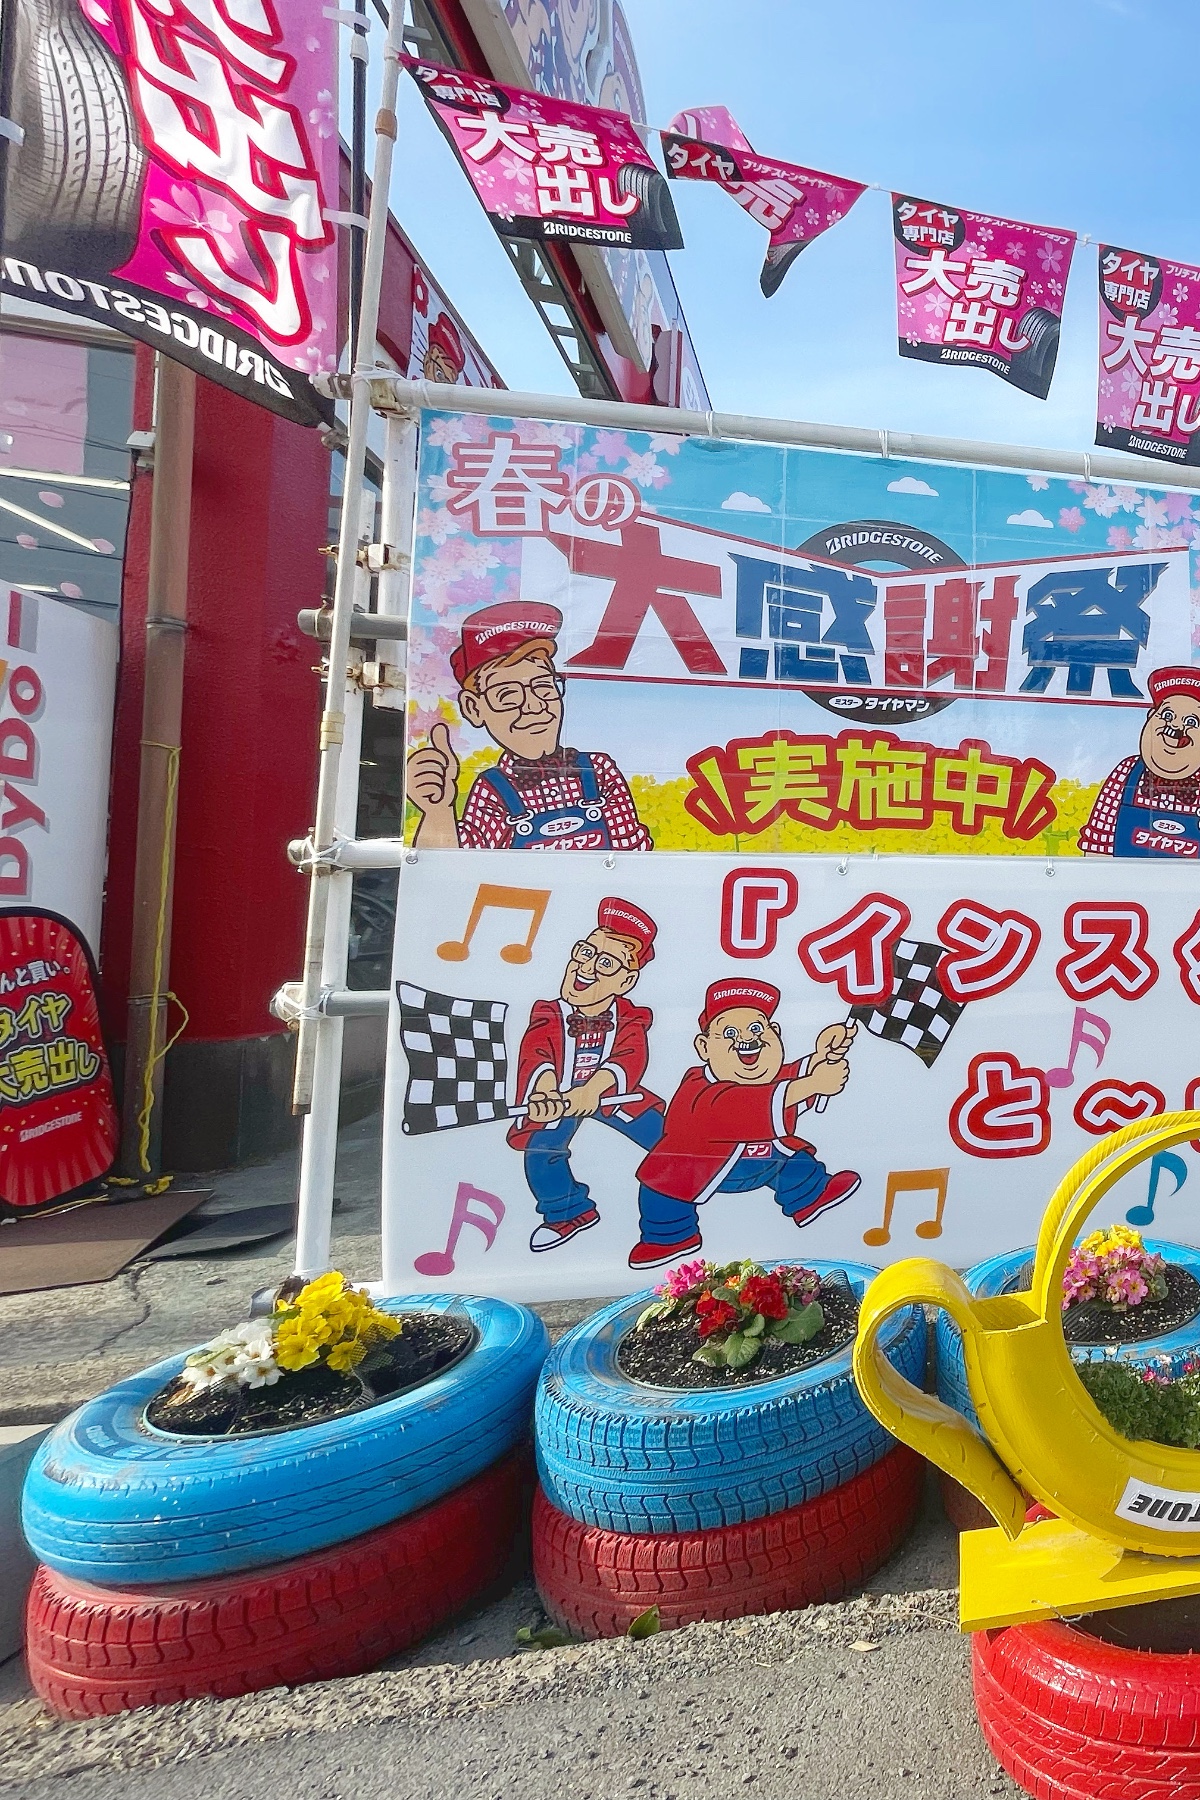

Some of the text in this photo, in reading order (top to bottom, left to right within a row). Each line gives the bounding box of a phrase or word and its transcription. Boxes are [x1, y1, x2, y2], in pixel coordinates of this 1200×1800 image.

[430, 85, 502, 108] 専門店
[457, 111, 603, 166] 大売
[667, 142, 735, 181] タイヤ
[537, 166, 639, 217] 出し
[897, 201, 959, 228] タイヤ
[543, 221, 632, 244] BRIDGESTONE
[902, 225, 955, 247] 専門店
[901, 249, 1026, 307] 大売
[1102, 252, 1159, 286] タイヤ
[1103, 281, 1152, 310] 専門店
[943, 301, 1031, 351] 出し
[940, 347, 1011, 375] BRIDGESTONE
[1127, 434, 1188, 459] BRIDGESTONE
[448, 433, 640, 536] 春の
[824, 531, 945, 565] BRIDGESTONE
[547, 522, 1171, 698] 大感謝祭
[474, 620, 558, 646] BRIDGESTONE
[864, 696, 930, 713] タイヤマン
[732, 734, 1016, 833] 実施中
[1135, 831, 1198, 855] タイヤマン
[603, 907, 652, 936] BRIDGESTONE
[713, 988, 775, 1003] BRIDGESTONE
